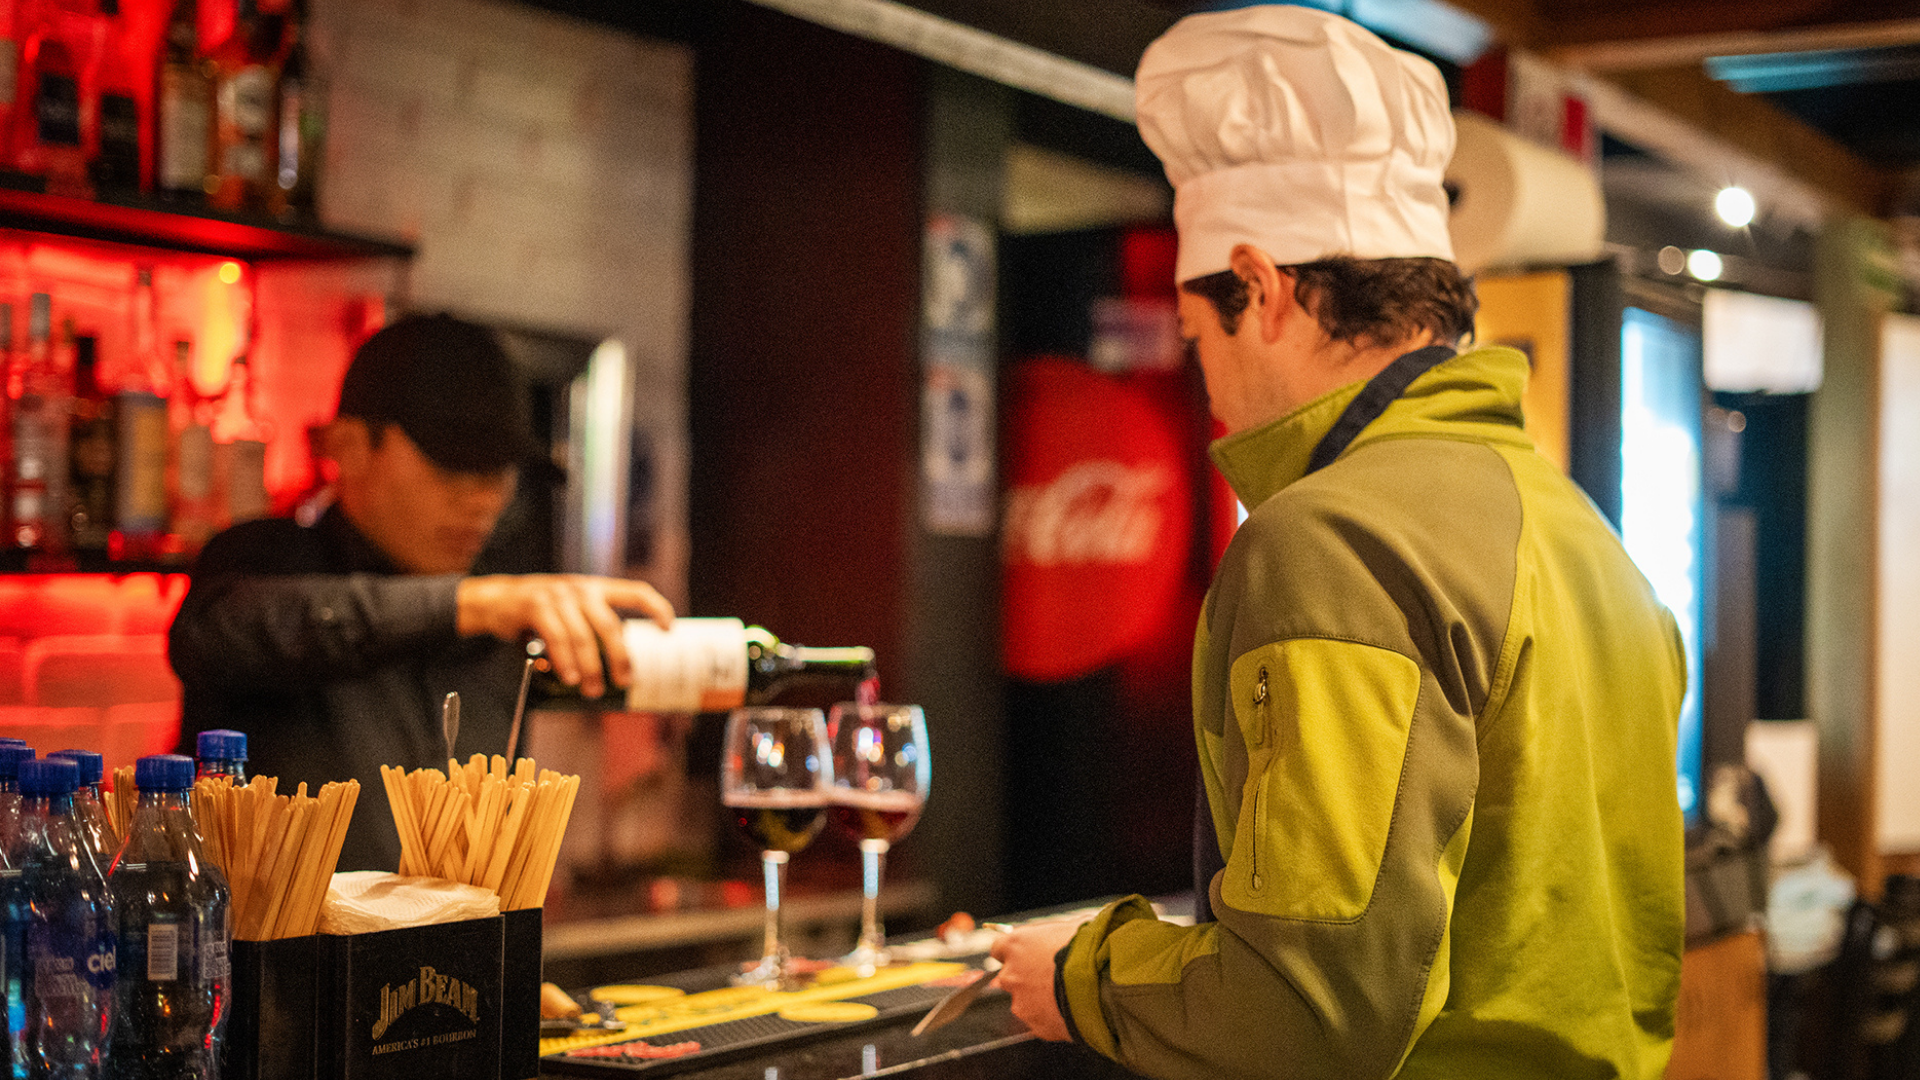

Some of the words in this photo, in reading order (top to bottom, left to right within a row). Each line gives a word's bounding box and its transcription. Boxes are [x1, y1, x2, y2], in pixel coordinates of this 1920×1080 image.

[87, 945, 117, 974] ciel
[419, 965, 479, 1025] BEAM
[372, 1038, 419, 1055] AMERICA'S
[433, 1029, 477, 1046] BOURBON
